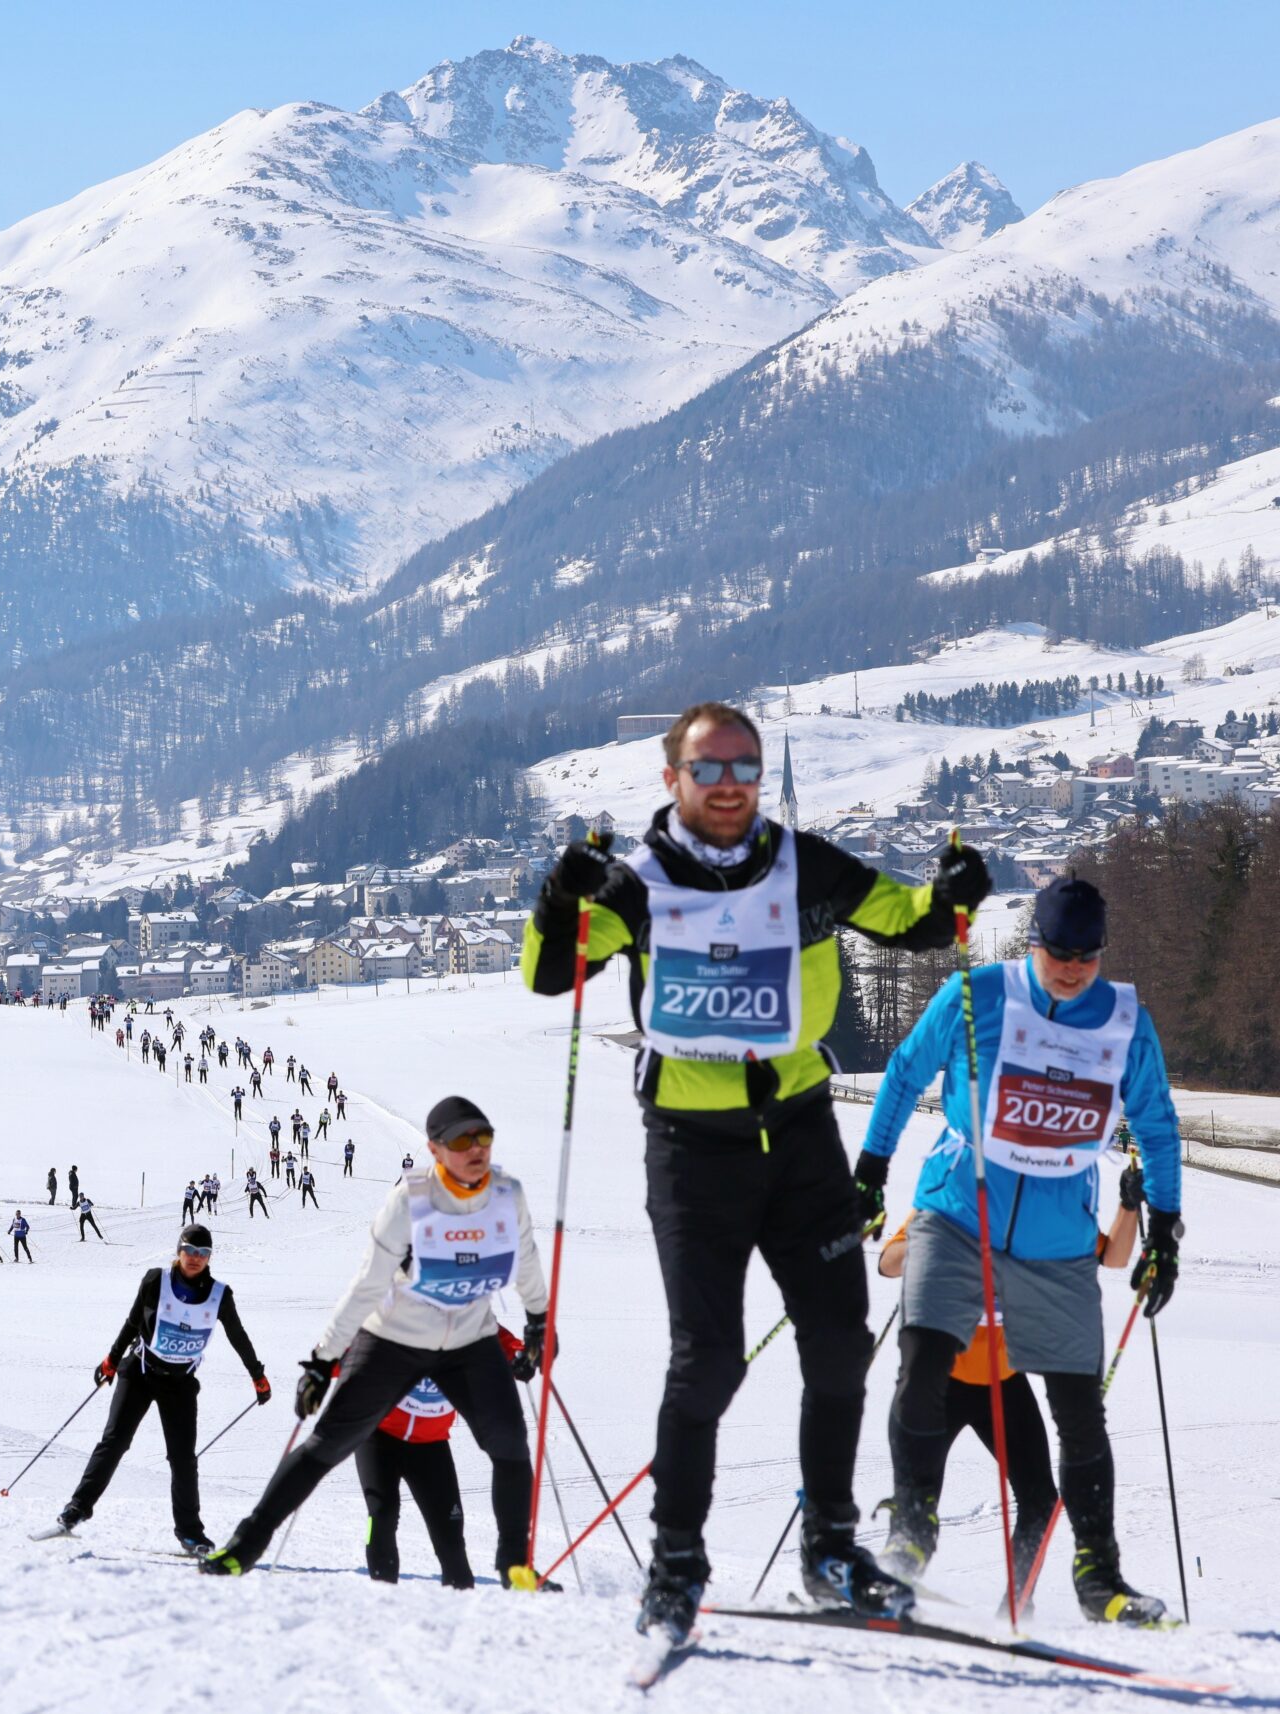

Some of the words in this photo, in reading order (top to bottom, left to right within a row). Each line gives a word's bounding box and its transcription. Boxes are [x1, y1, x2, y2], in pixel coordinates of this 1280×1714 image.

[661, 984, 779, 1019] 27020
[674, 1045, 738, 1062] helvetia
[1049, 1070, 1070, 1081] G20
[1003, 1096, 1100, 1131] 20270
[1010, 1151, 1061, 1167] helvetia
[445, 1229, 485, 1242] coop
[160, 1336, 205, 1353] 26203
